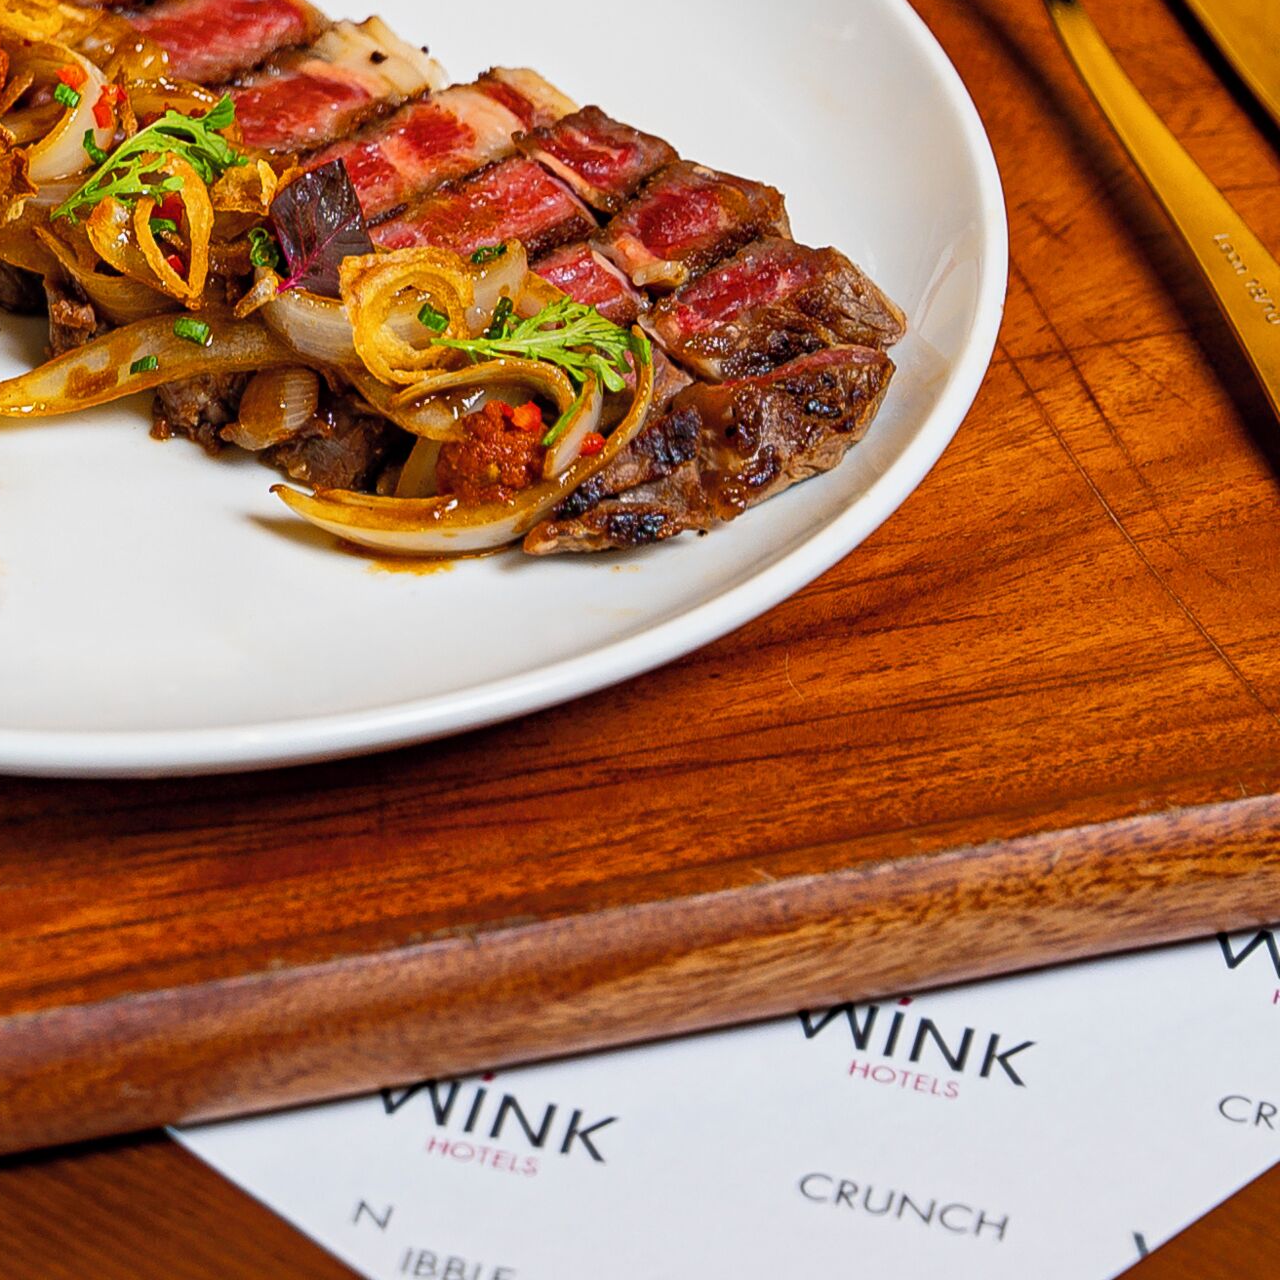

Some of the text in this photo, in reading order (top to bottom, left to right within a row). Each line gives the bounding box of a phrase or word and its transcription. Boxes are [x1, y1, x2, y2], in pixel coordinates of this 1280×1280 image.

[848, 1059, 960, 1100] HOTELS
[424, 1135, 540, 1178] HOTELS
[798, 1171, 1011, 1242] CRUNCH
